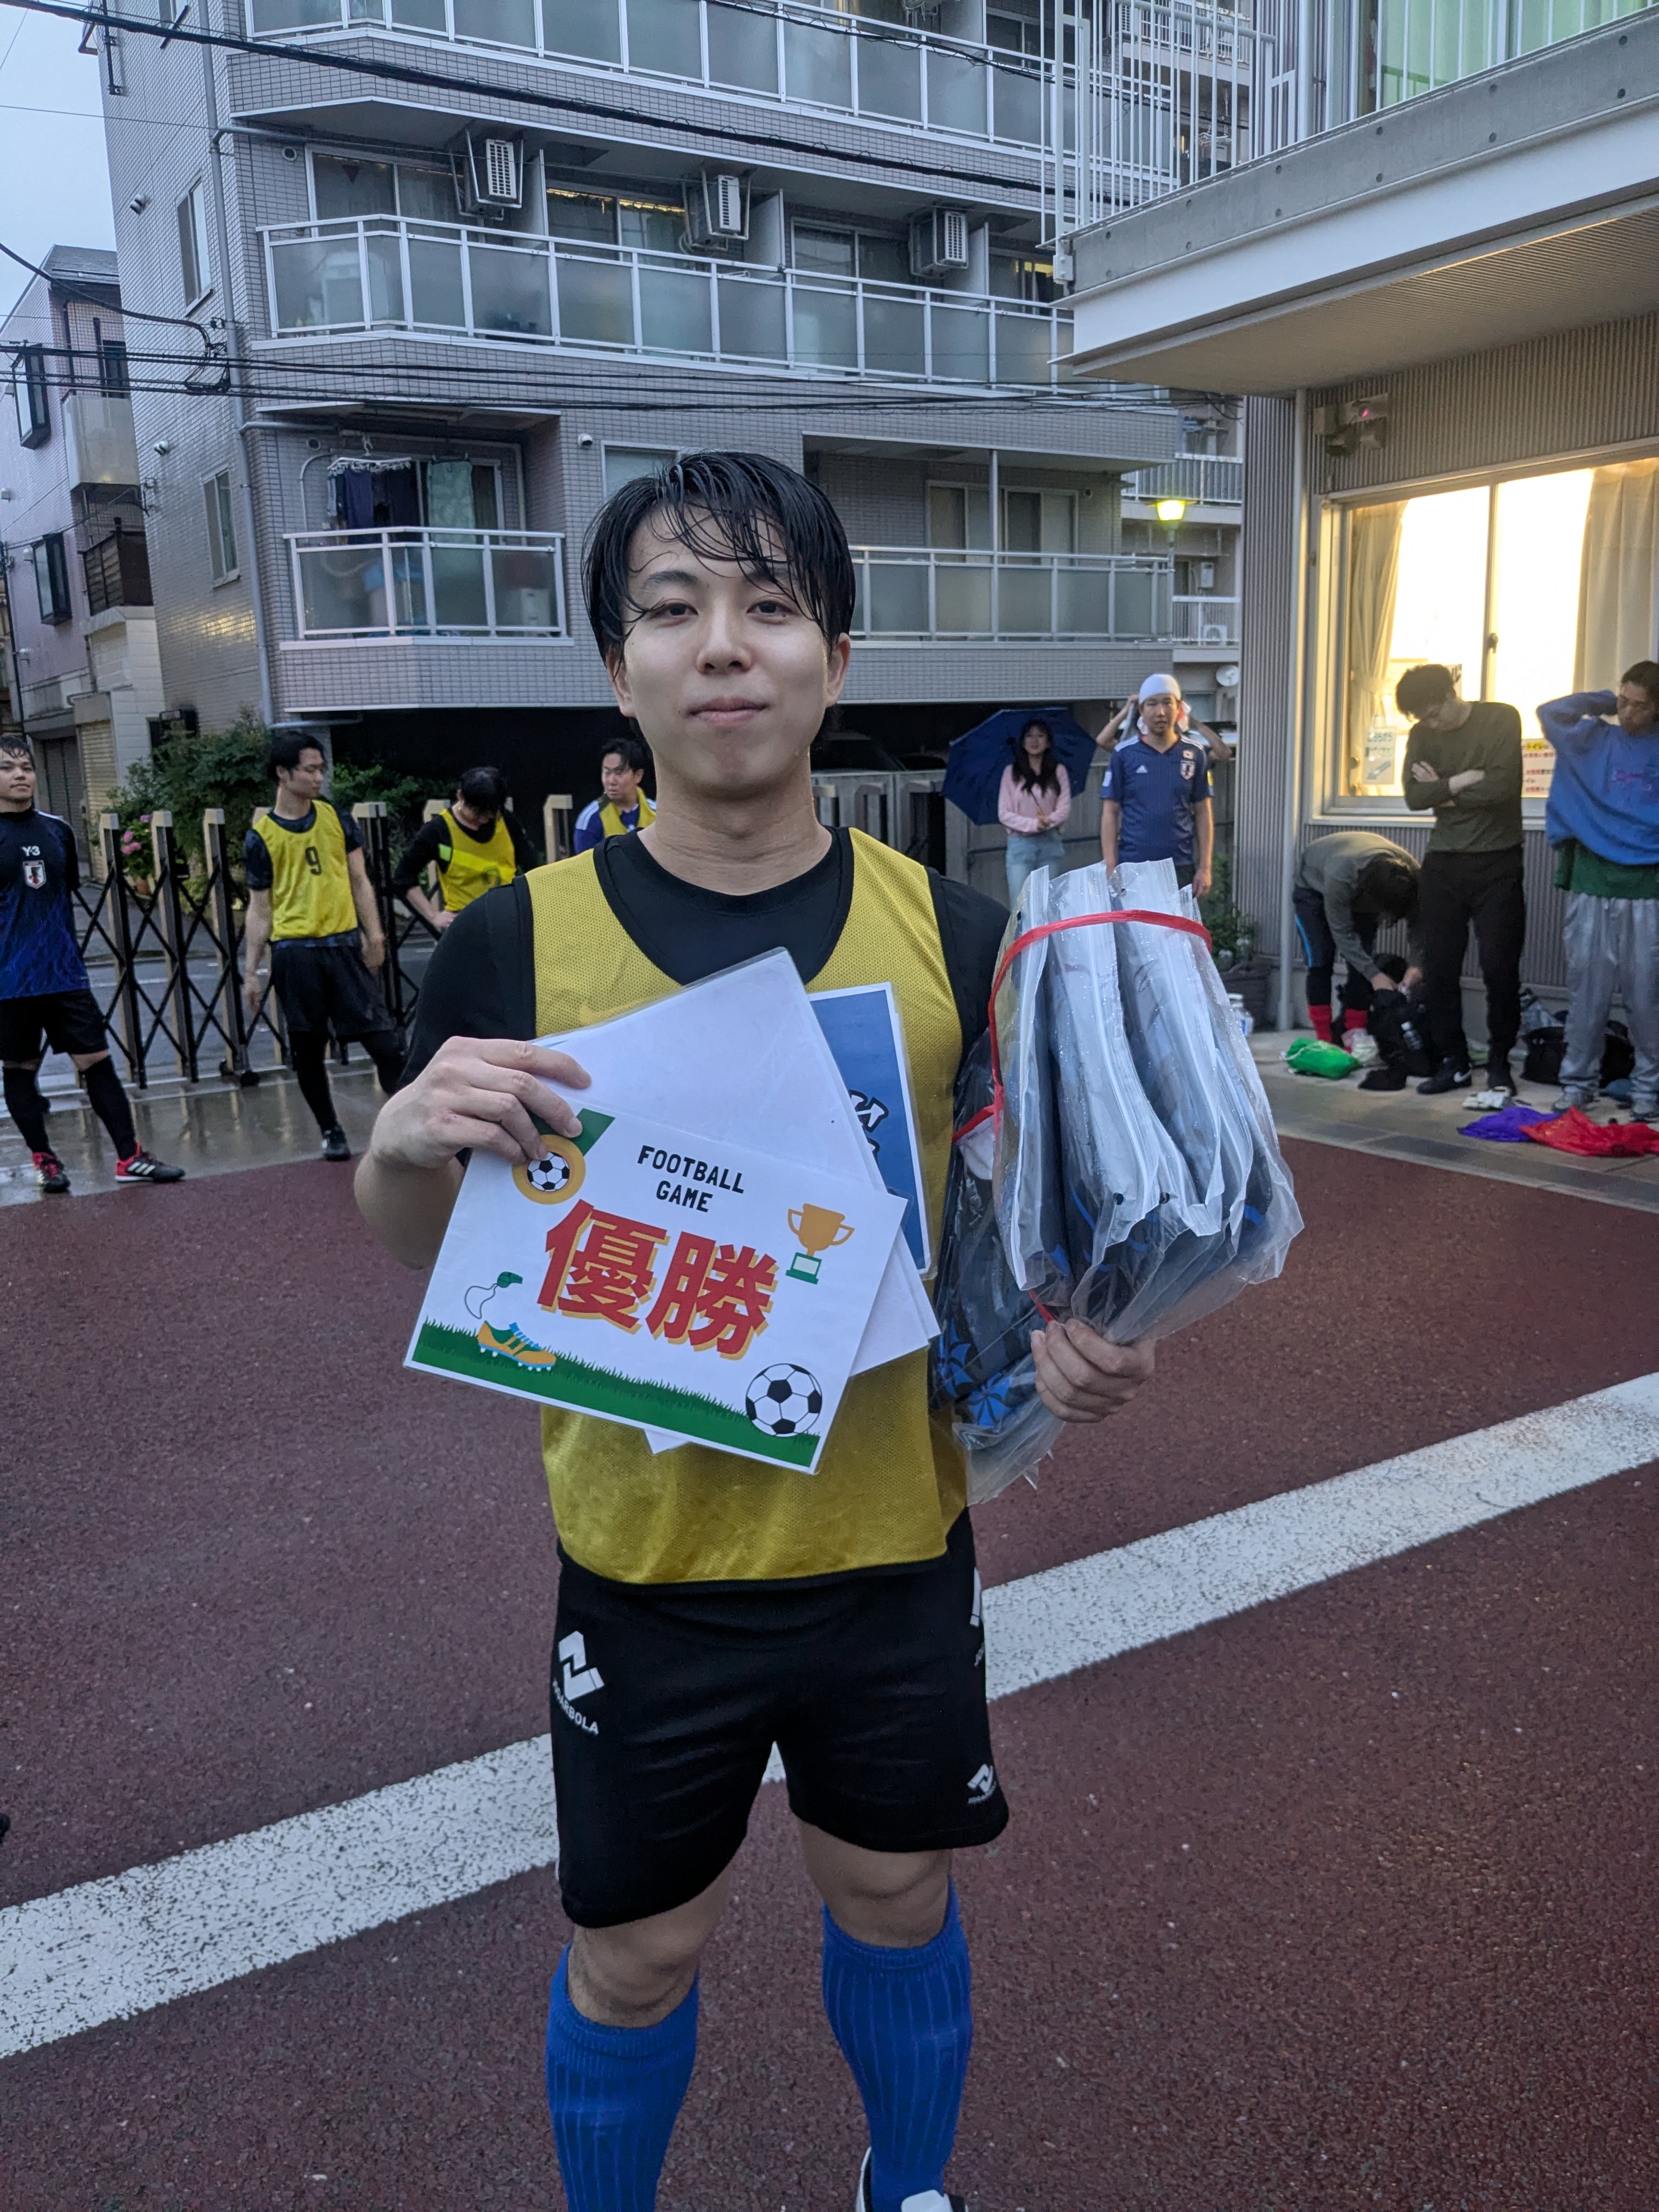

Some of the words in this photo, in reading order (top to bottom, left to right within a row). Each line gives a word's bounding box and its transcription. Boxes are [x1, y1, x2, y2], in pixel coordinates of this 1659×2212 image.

[305, 846, 323, 876] 9
[637, 1144, 744, 1194] FOOTBALL
[656, 1180, 714, 1213] GAME
[537, 1199, 780, 1361] 優勝
